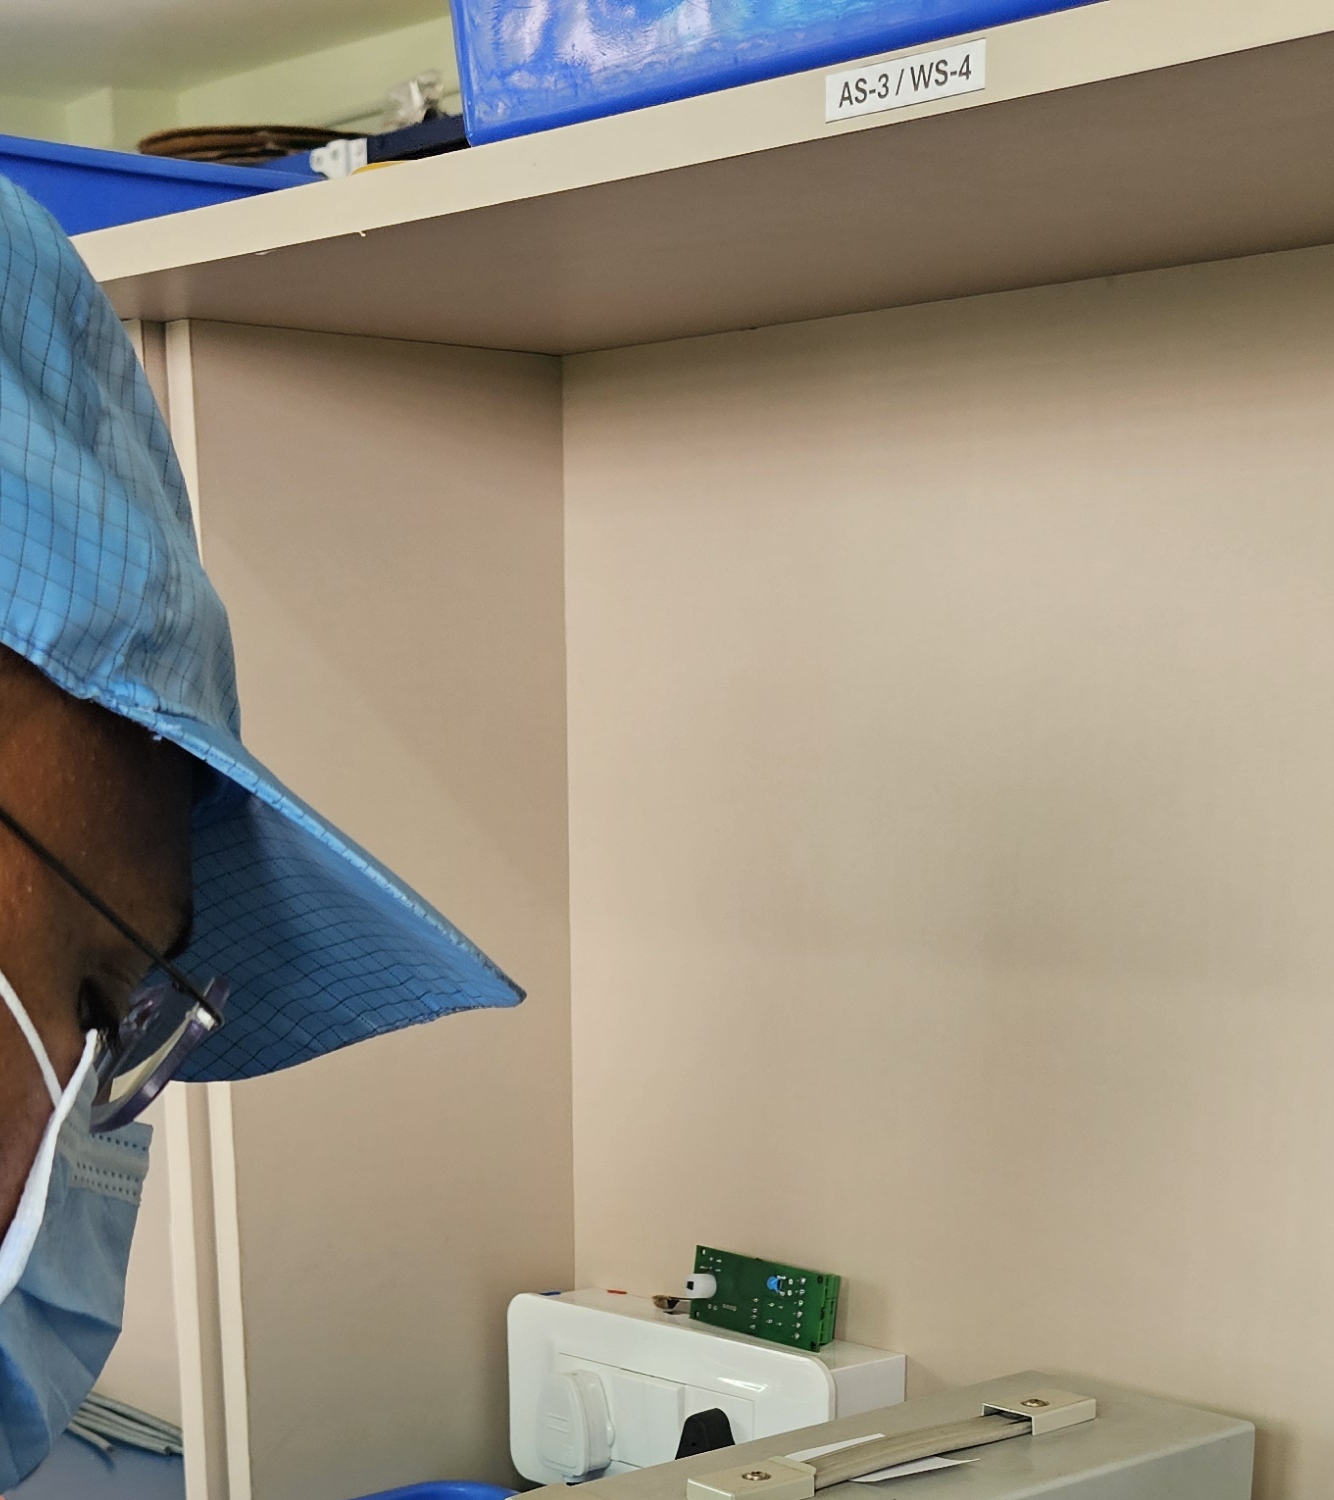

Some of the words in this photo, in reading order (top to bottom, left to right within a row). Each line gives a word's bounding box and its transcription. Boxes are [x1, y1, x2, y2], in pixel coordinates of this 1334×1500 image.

[838, 73, 890, 108] AS-3
[895, 68, 905, 96] /
[910, 54, 972, 92] WS-4
